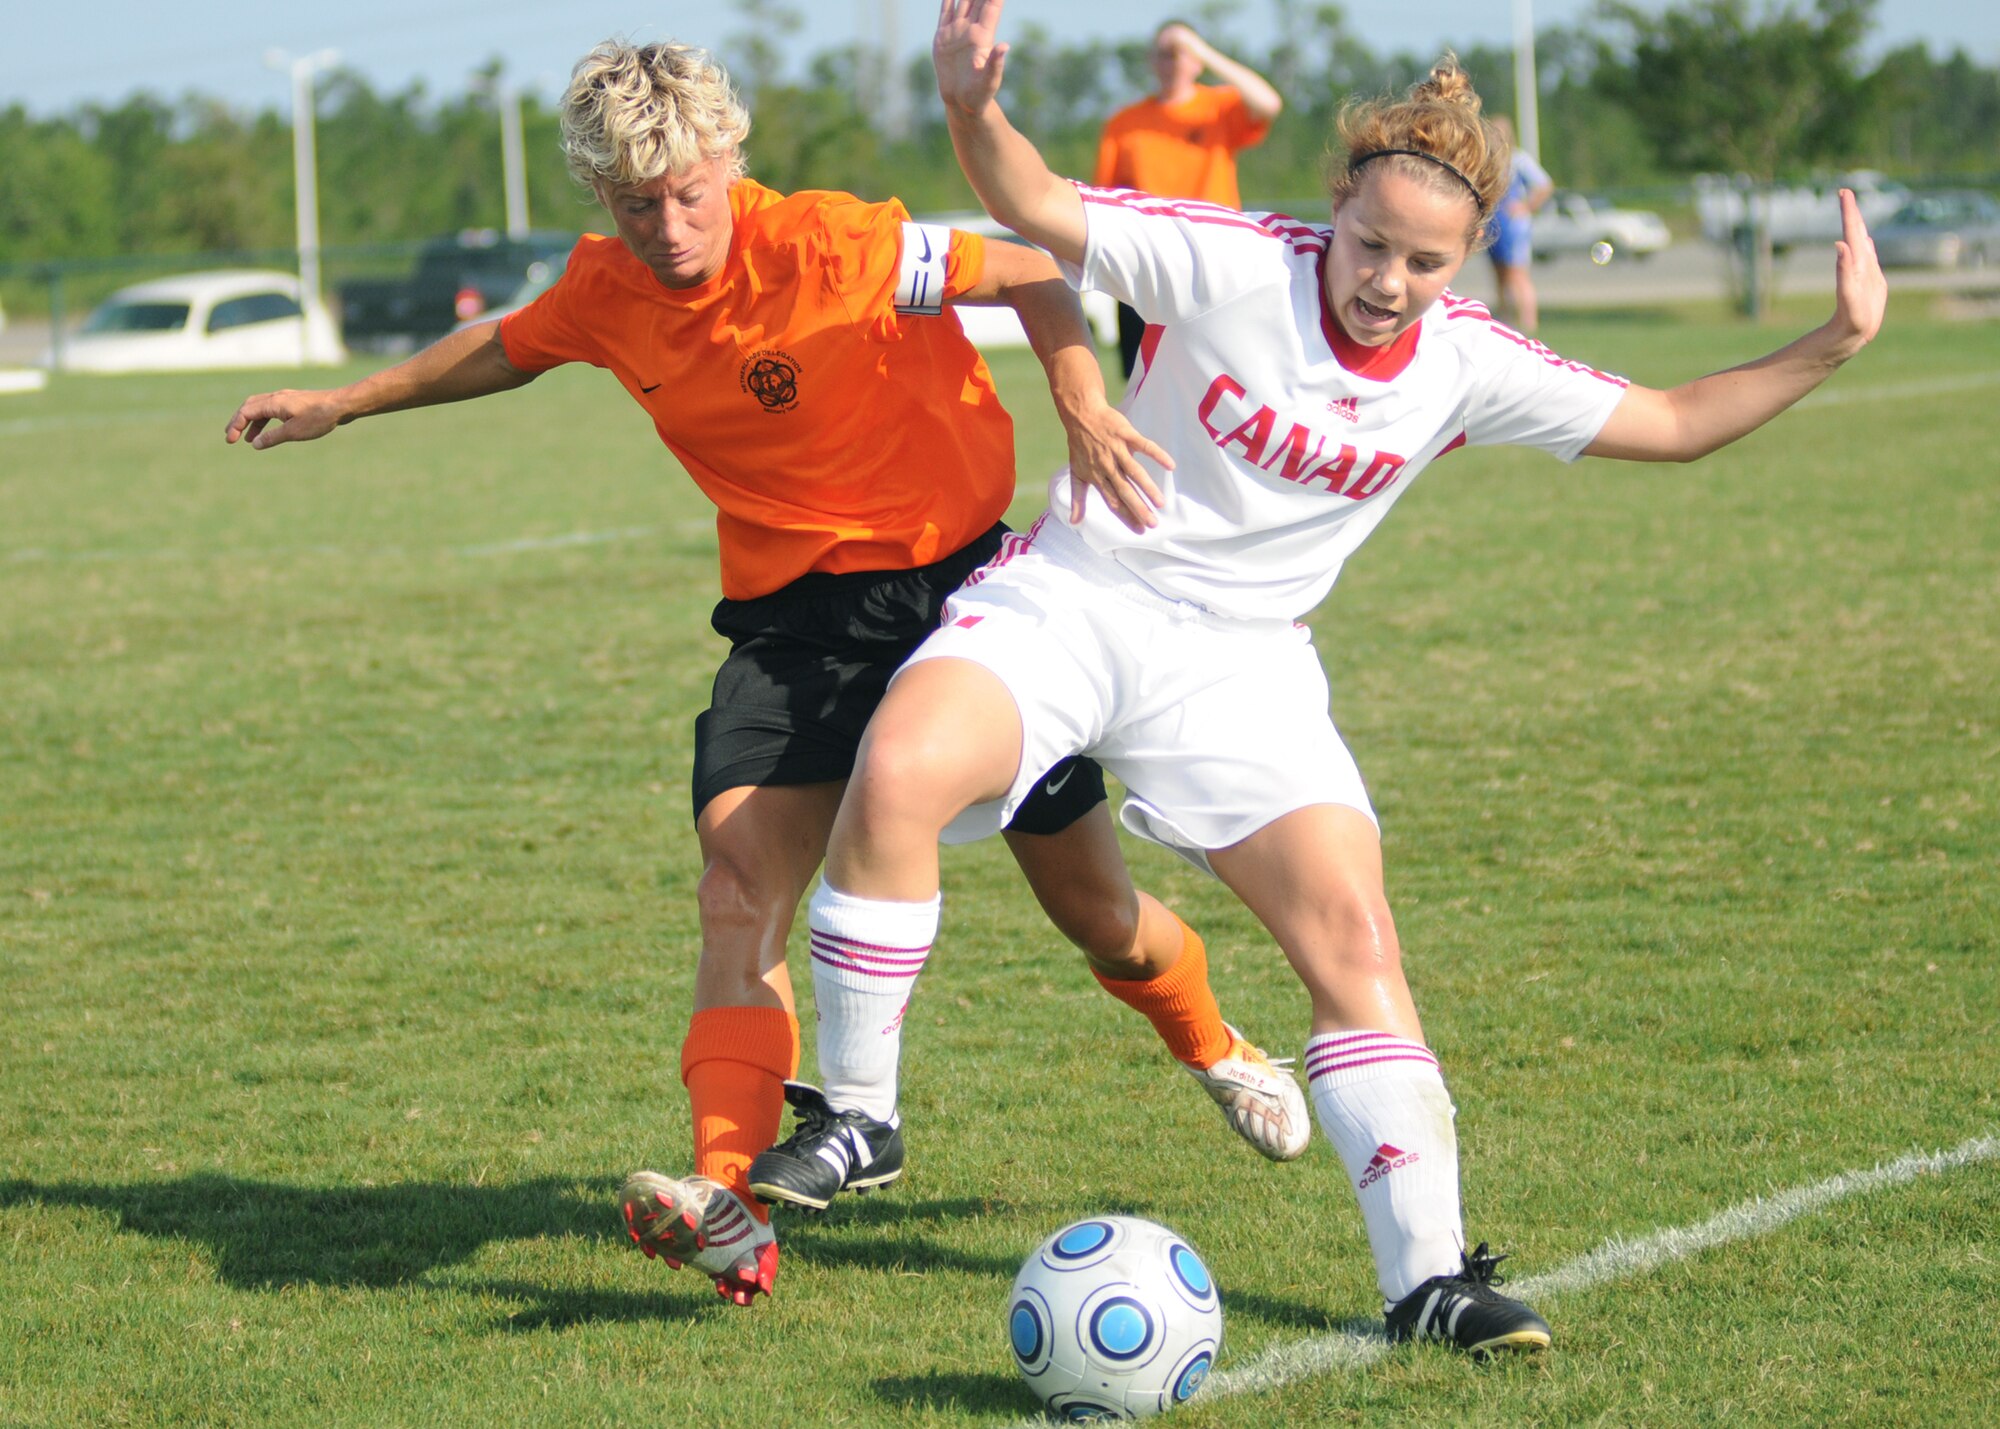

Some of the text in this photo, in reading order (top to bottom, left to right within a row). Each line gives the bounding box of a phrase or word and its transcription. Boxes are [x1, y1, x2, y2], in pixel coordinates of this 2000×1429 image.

[762, 350, 803, 374] DELEGATION
[1326, 403, 1360, 424] adidas
[1227, 1067, 1256, 1085] Judith
[1359, 1152, 1420, 1189] adidas
